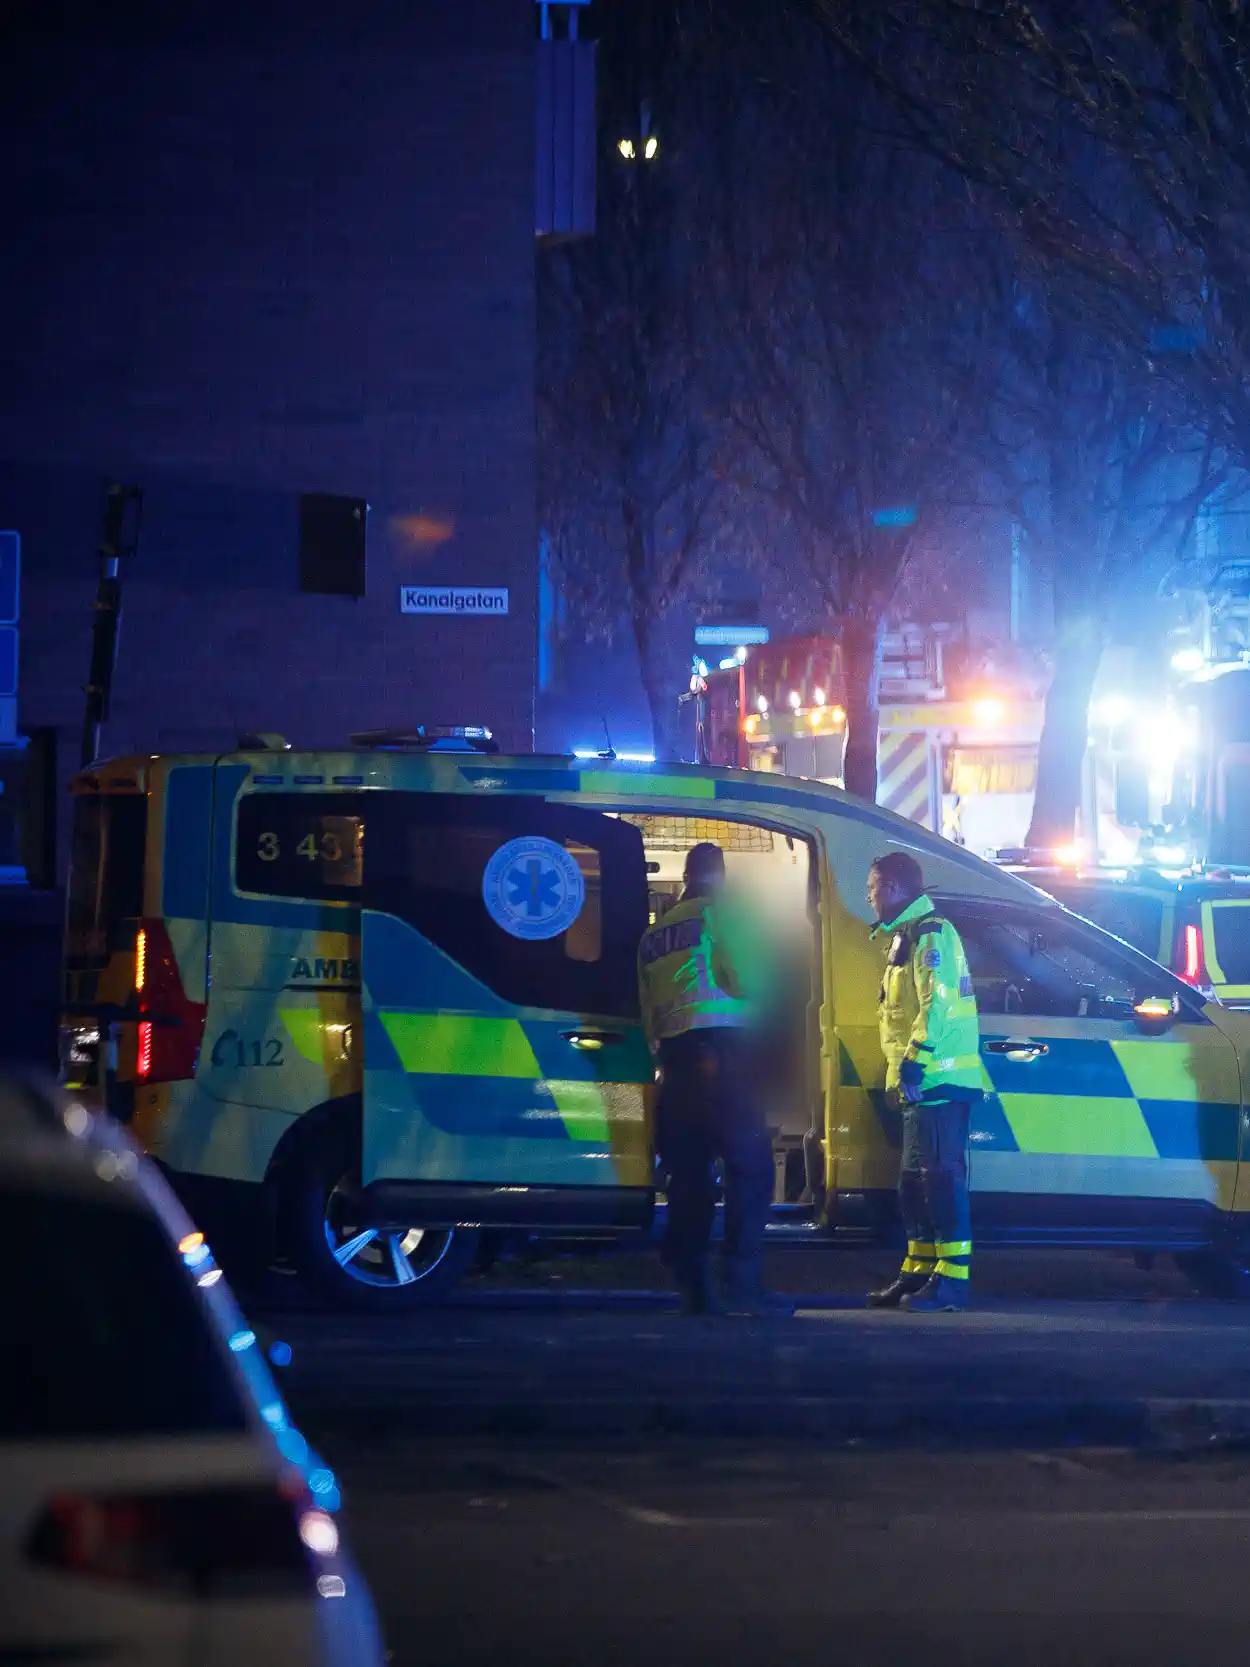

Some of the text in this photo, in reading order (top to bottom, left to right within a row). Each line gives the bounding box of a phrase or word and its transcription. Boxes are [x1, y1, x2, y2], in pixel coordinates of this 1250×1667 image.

[405, 591, 504, 609] Kanalgatan
[256, 831, 280, 861] 3
[234, 1038, 285, 1067] 112
